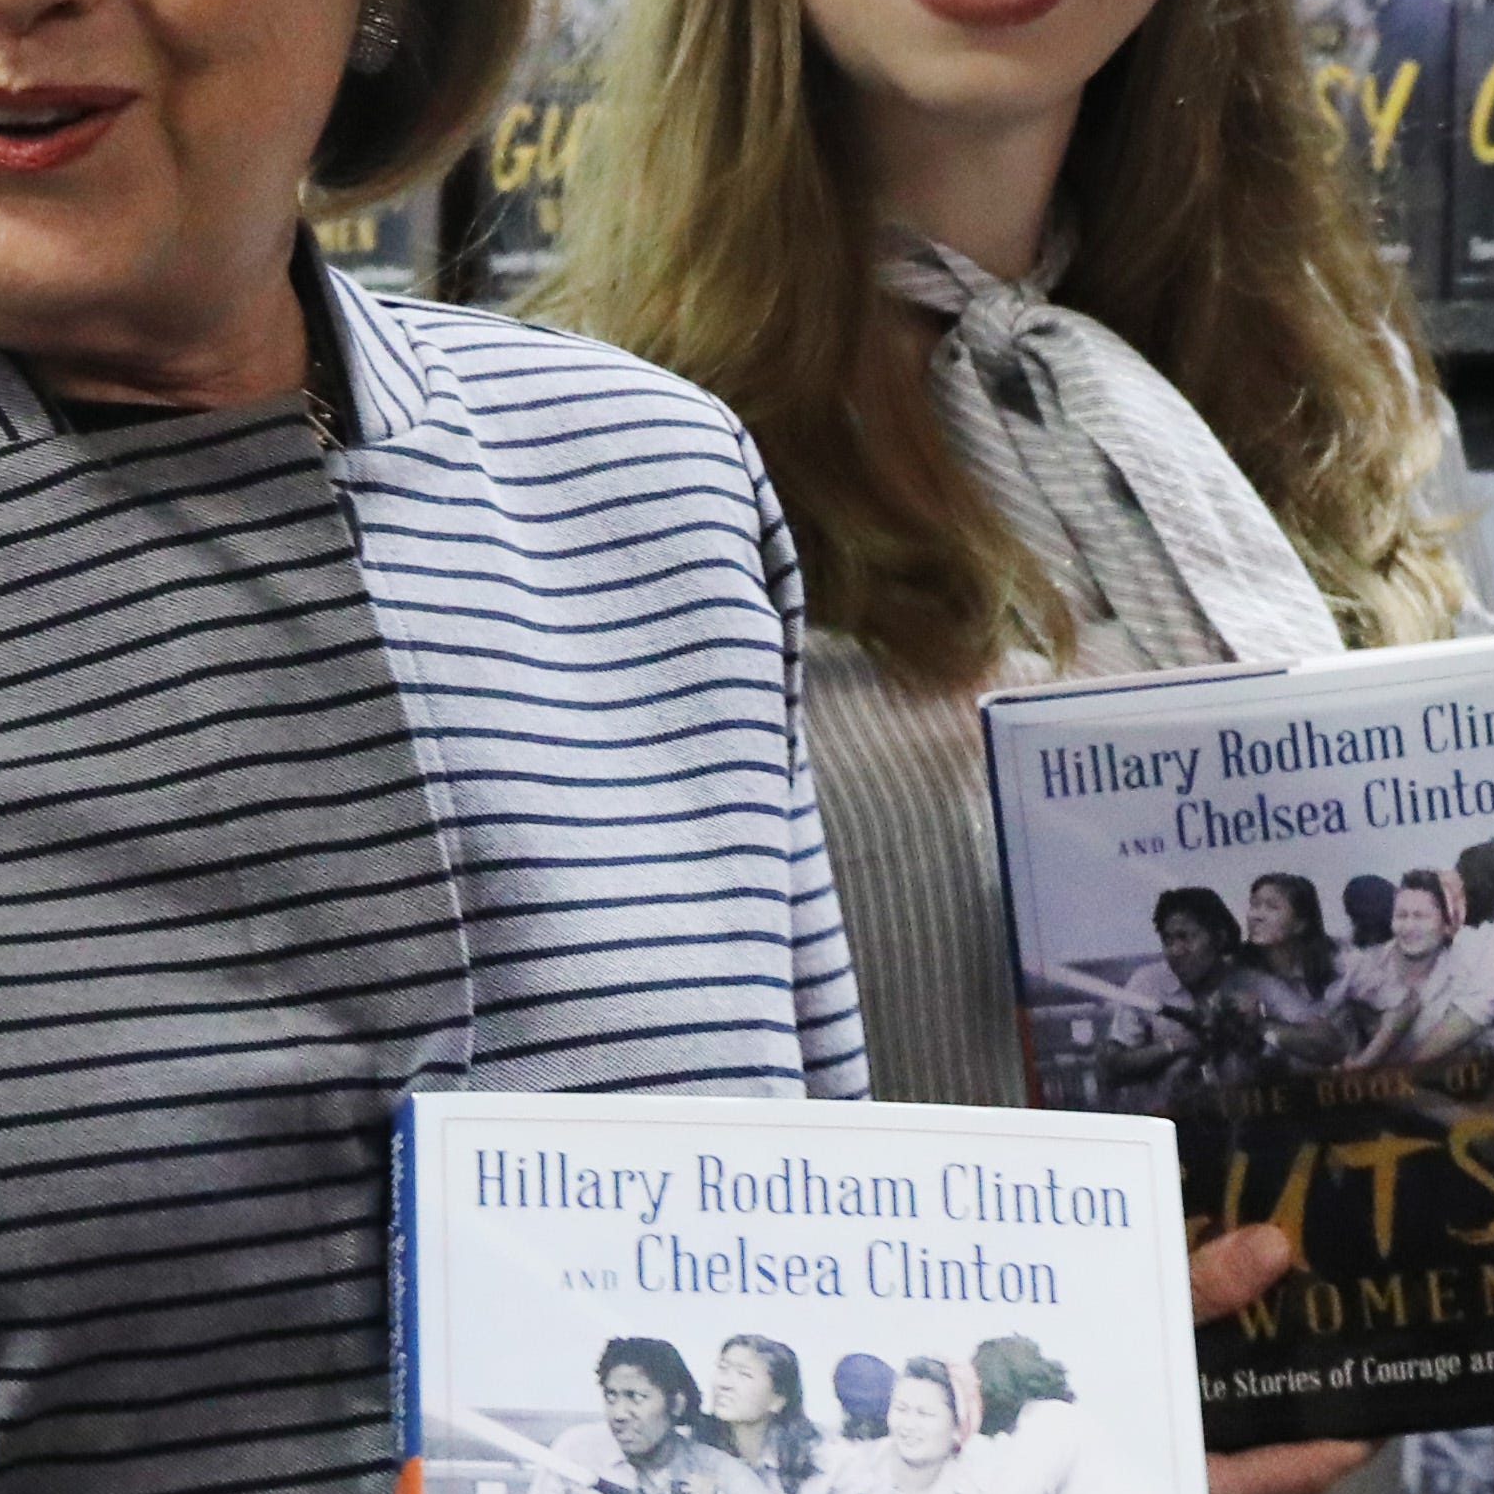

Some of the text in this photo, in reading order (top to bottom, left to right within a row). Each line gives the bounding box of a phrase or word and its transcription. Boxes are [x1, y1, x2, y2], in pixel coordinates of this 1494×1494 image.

[1040, 744, 1202, 801] Hillary
[1219, 718, 1406, 777] Rodham
[1117, 836, 1166, 858] AND
[1176, 792, 1348, 850] Chelsea
[475, 1149, 1129, 1227] Hillary Rodham Clinton
[560, 1233, 1058, 1304] AND Chelsea Clinton
[1231, 1365, 1324, 1398] Stories
[1327, 1355, 1358, 1387] of
[1361, 1351, 1466, 1383] Courage
